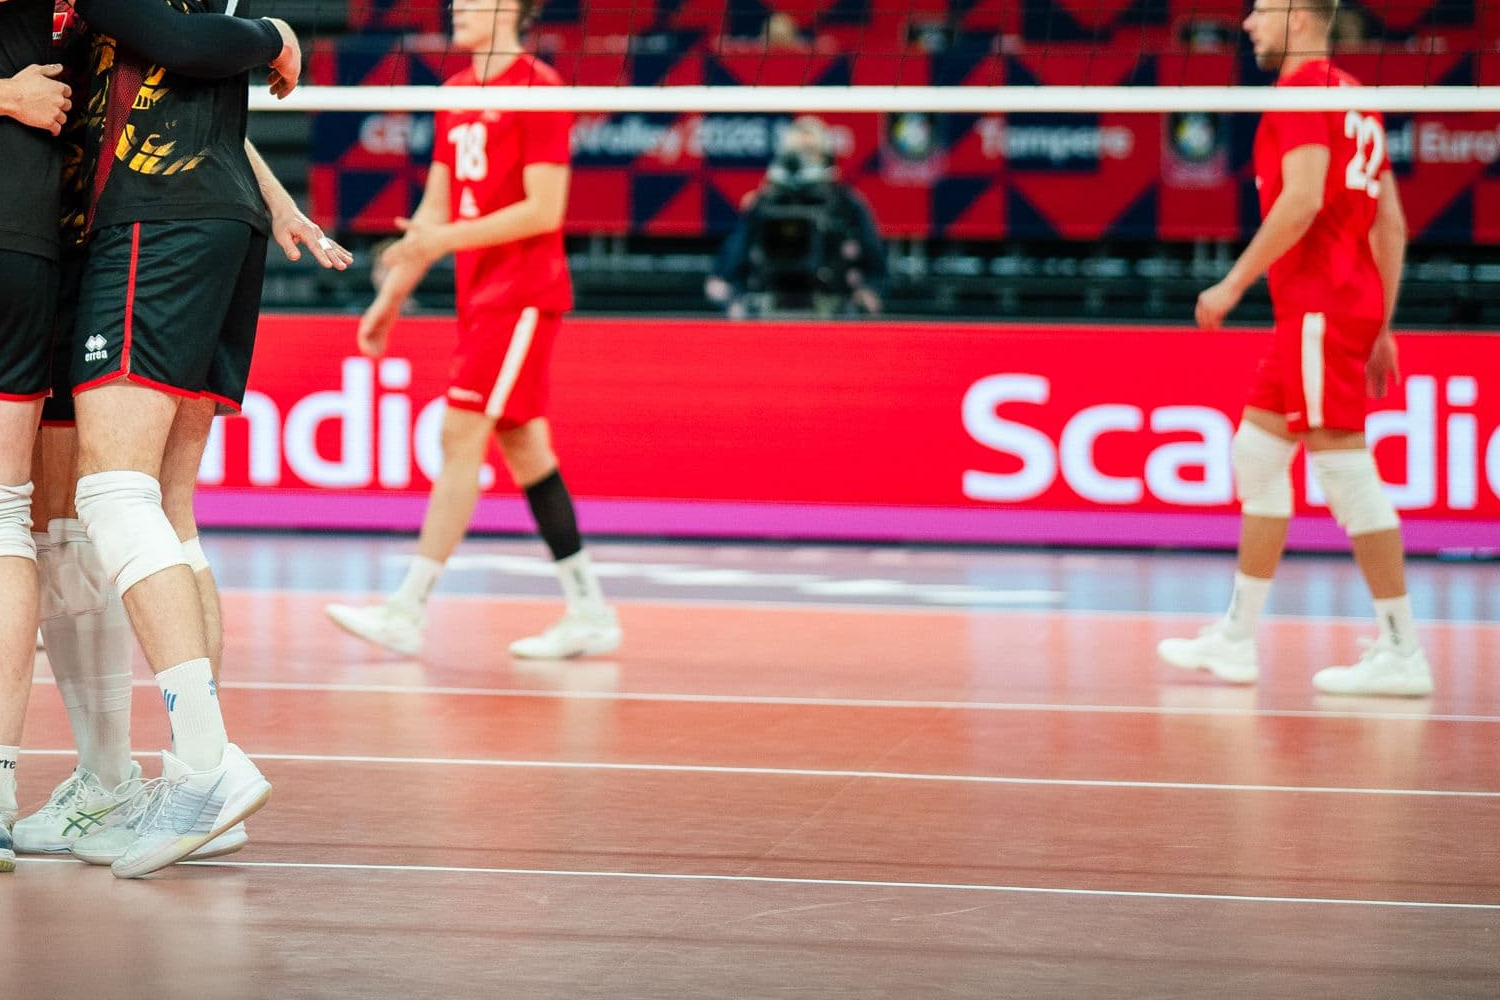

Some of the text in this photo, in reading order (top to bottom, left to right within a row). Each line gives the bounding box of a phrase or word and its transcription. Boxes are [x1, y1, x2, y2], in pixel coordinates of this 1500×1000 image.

[447, 121, 488, 182] 18
[1343, 110, 1384, 199] 22
[199, 357, 496, 488] ndic
[961, 372, 1500, 511] Scadi
